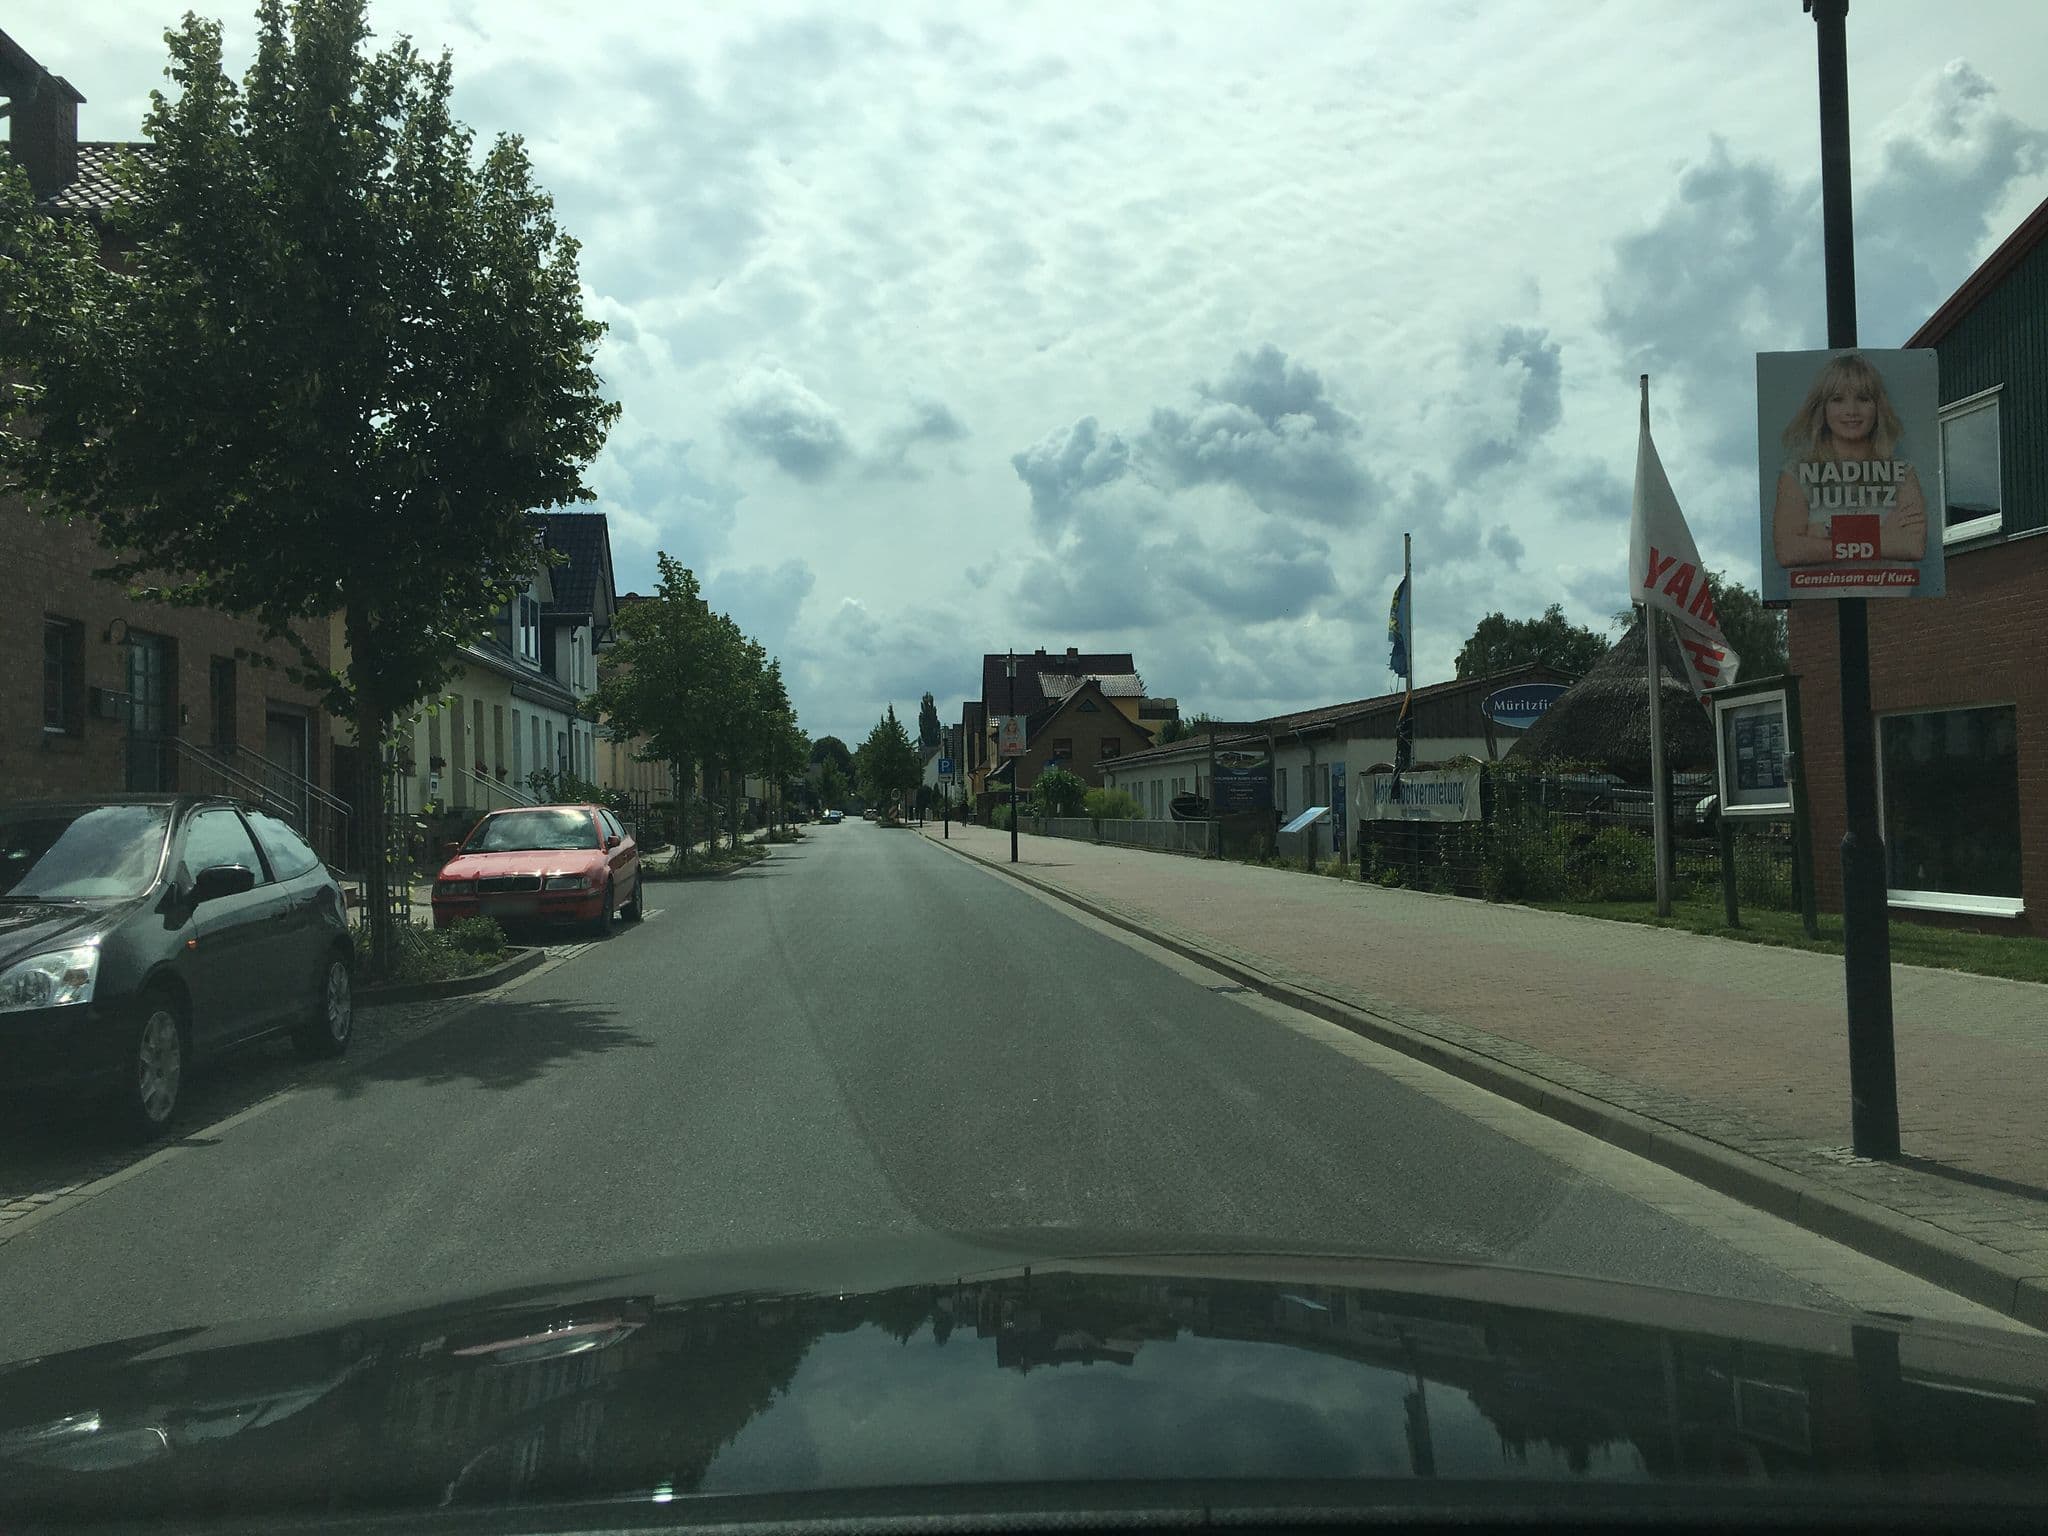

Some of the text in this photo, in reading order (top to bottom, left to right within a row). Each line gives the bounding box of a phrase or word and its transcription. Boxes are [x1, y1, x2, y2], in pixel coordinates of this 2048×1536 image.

[1800, 460, 1906, 483] NADINE
[1810, 485, 1897, 508] JULITZ
[1835, 542, 1874, 559] SPD
[1795, 572, 1916, 585] Gemeinsam auf Kurs.
[941, 760, 950, 772] P
